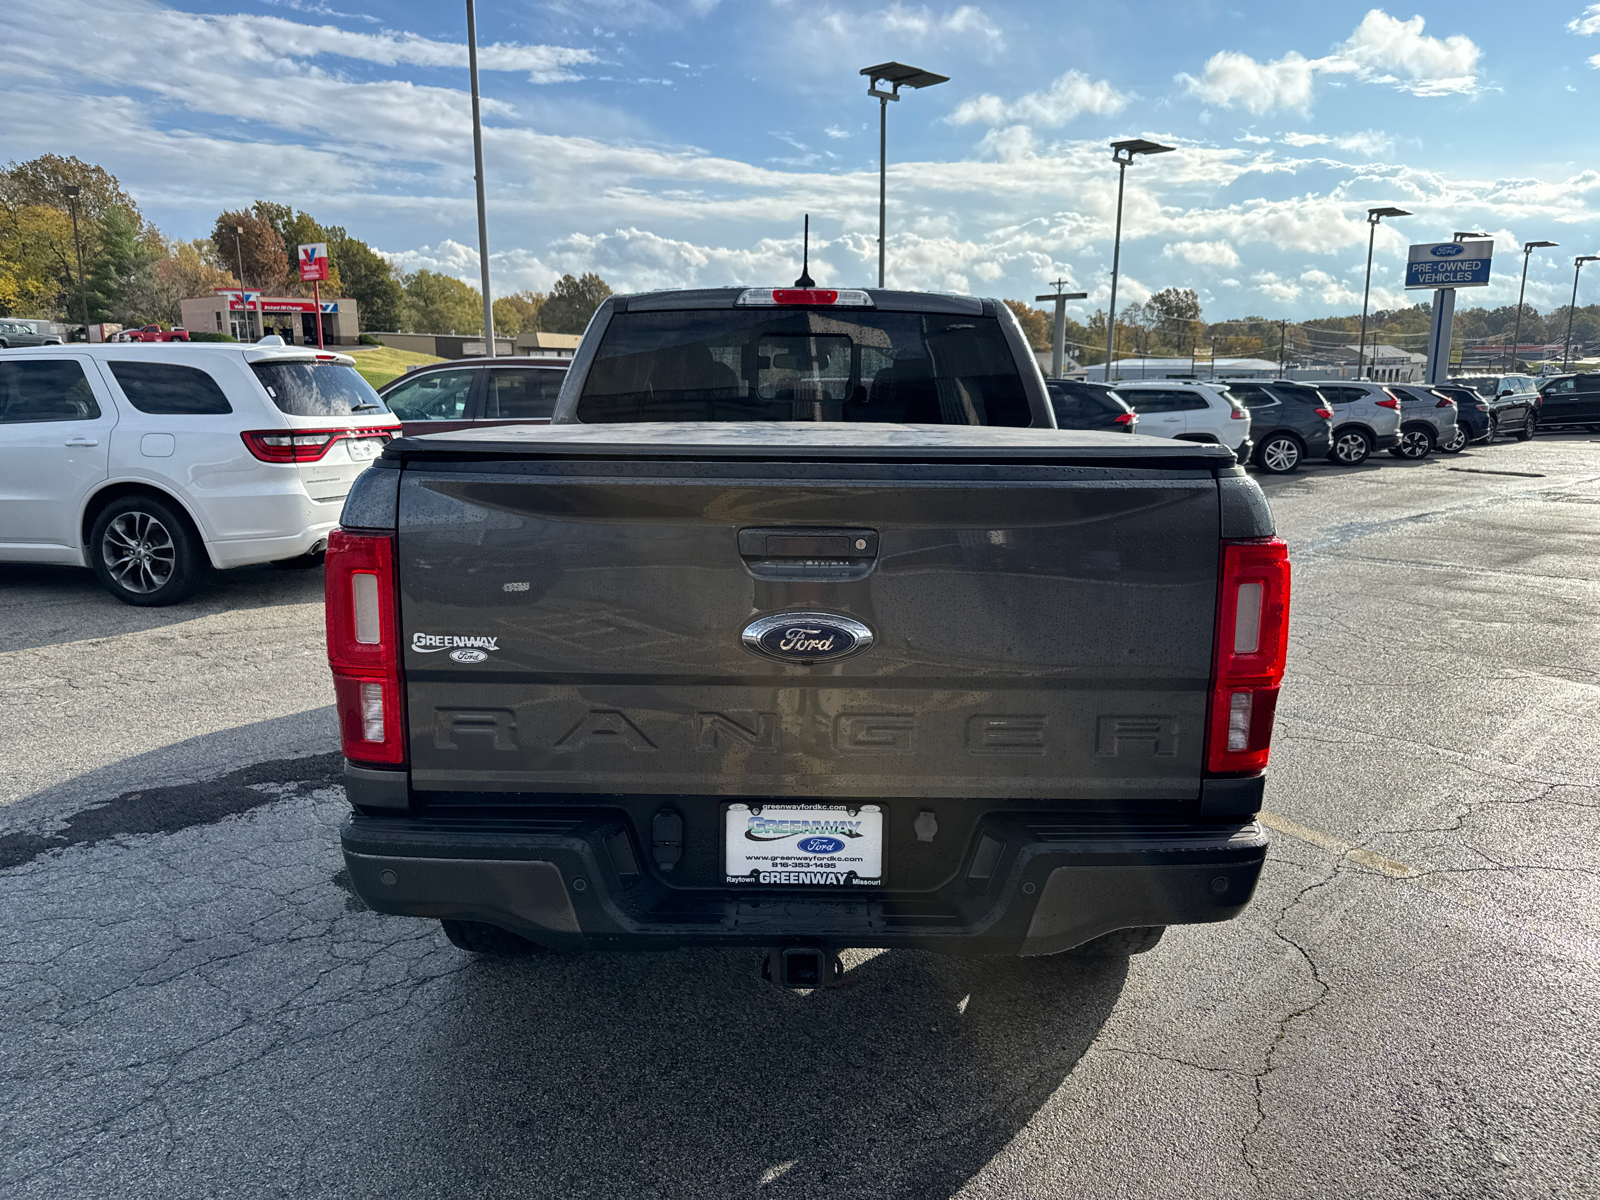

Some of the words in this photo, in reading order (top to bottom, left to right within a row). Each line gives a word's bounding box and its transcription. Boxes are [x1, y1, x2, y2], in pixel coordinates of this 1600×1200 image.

[1436, 246, 1458, 255] Ford
[1418, 272, 1472, 283] VEHICLES
[779, 628, 834, 652] Ford
[457, 651, 480, 661] Ford
[433, 705, 1180, 759] RANGER
[762, 803, 847, 811] greenwayfordkc.com
[807, 838, 834, 852] Ford
[745, 855, 863, 863] www.greenwayfordkc.com
[726, 876, 755, 884] Raytown
[759, 871, 848, 885] GREENWAY
[852, 878, 881, 886] Missouri
